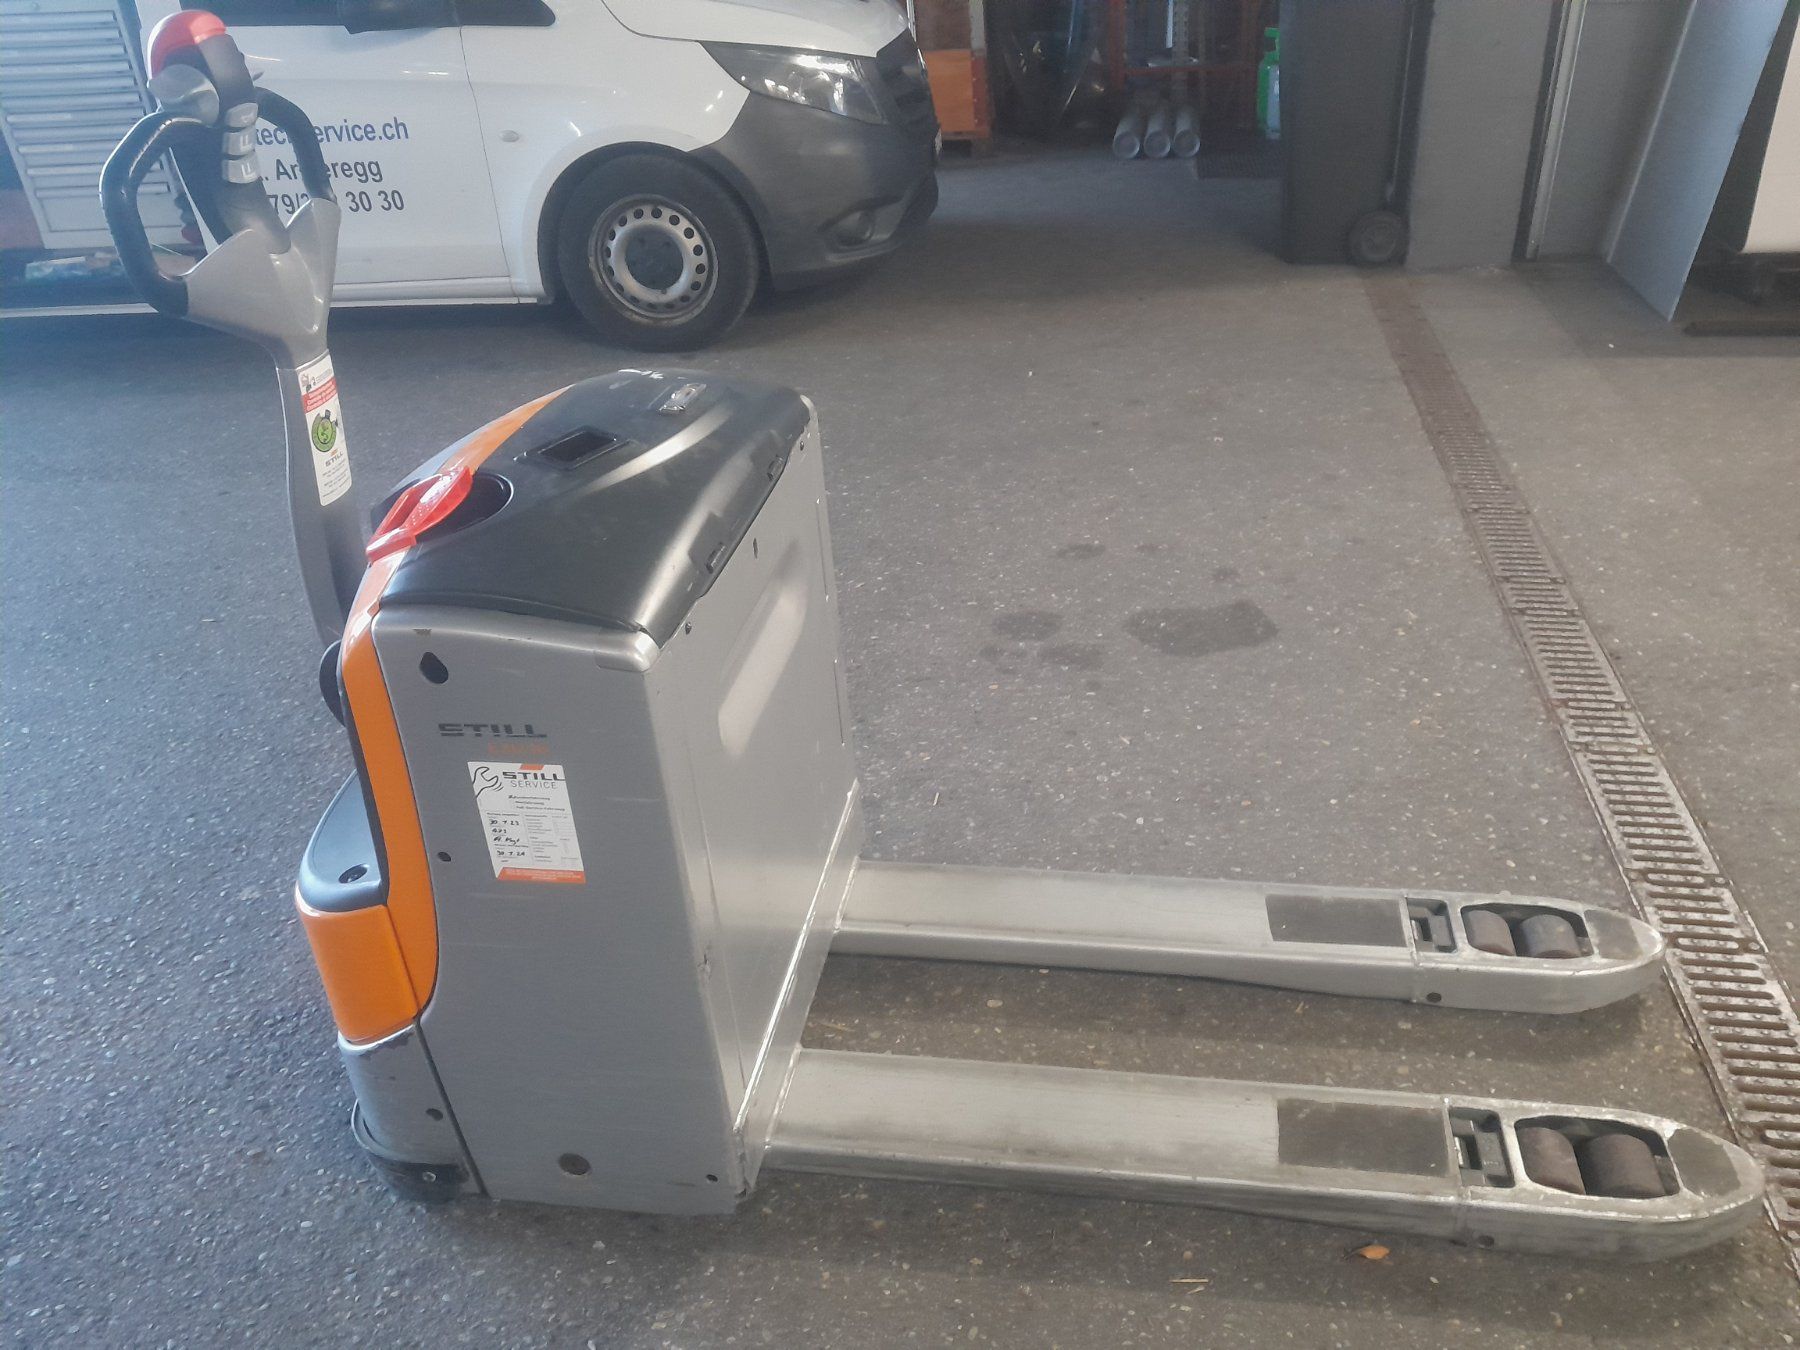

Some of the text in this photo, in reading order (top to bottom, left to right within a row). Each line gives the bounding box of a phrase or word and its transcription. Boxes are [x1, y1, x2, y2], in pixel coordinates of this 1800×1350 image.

[345, 191, 372, 213] 30
[378, 190, 404, 211] 30
[438, 723, 547, 738] STILL
[502, 771, 566, 781] STILL
[510, 780, 558, 789] SERVICE
